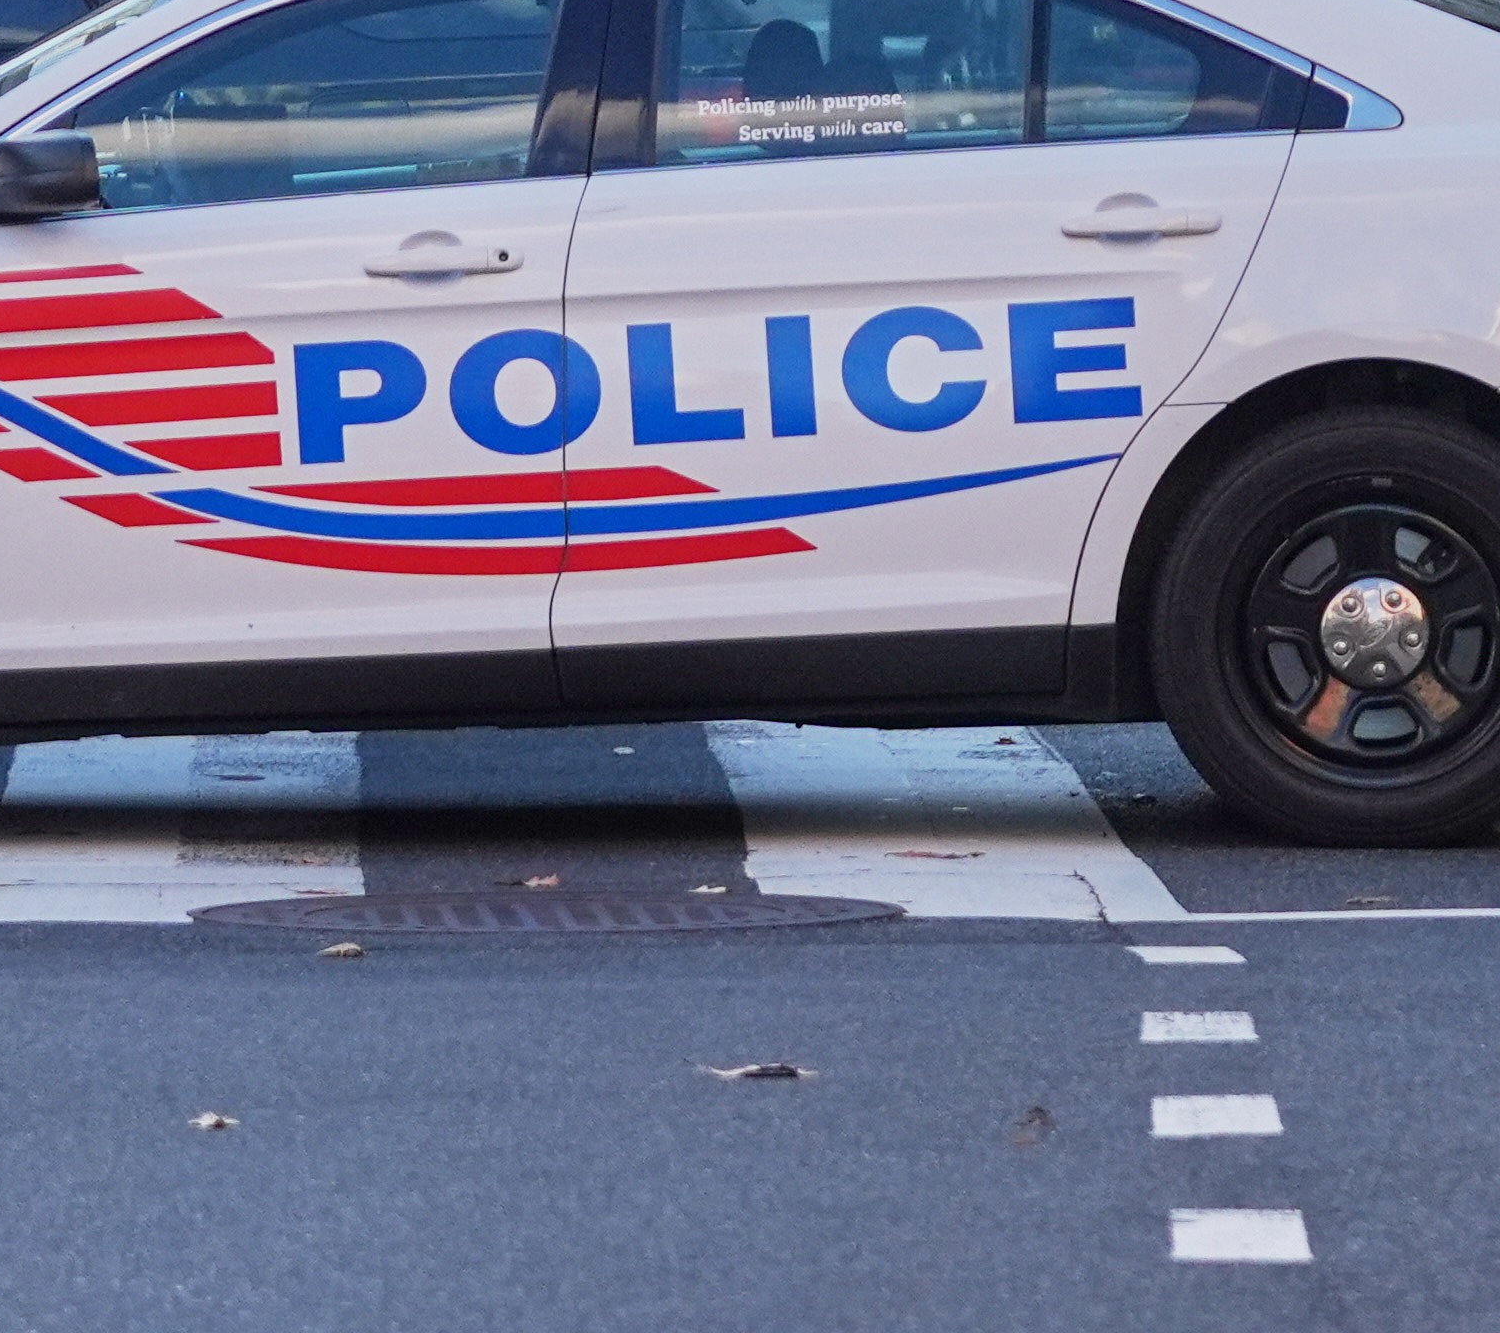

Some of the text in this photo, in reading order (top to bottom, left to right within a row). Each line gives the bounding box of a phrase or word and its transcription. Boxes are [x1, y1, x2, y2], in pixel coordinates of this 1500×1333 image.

[698, 94, 906, 116] Policing with purpose.
[739, 120, 907, 142] Serving with care.
[293, 296, 1142, 464] POLICE
